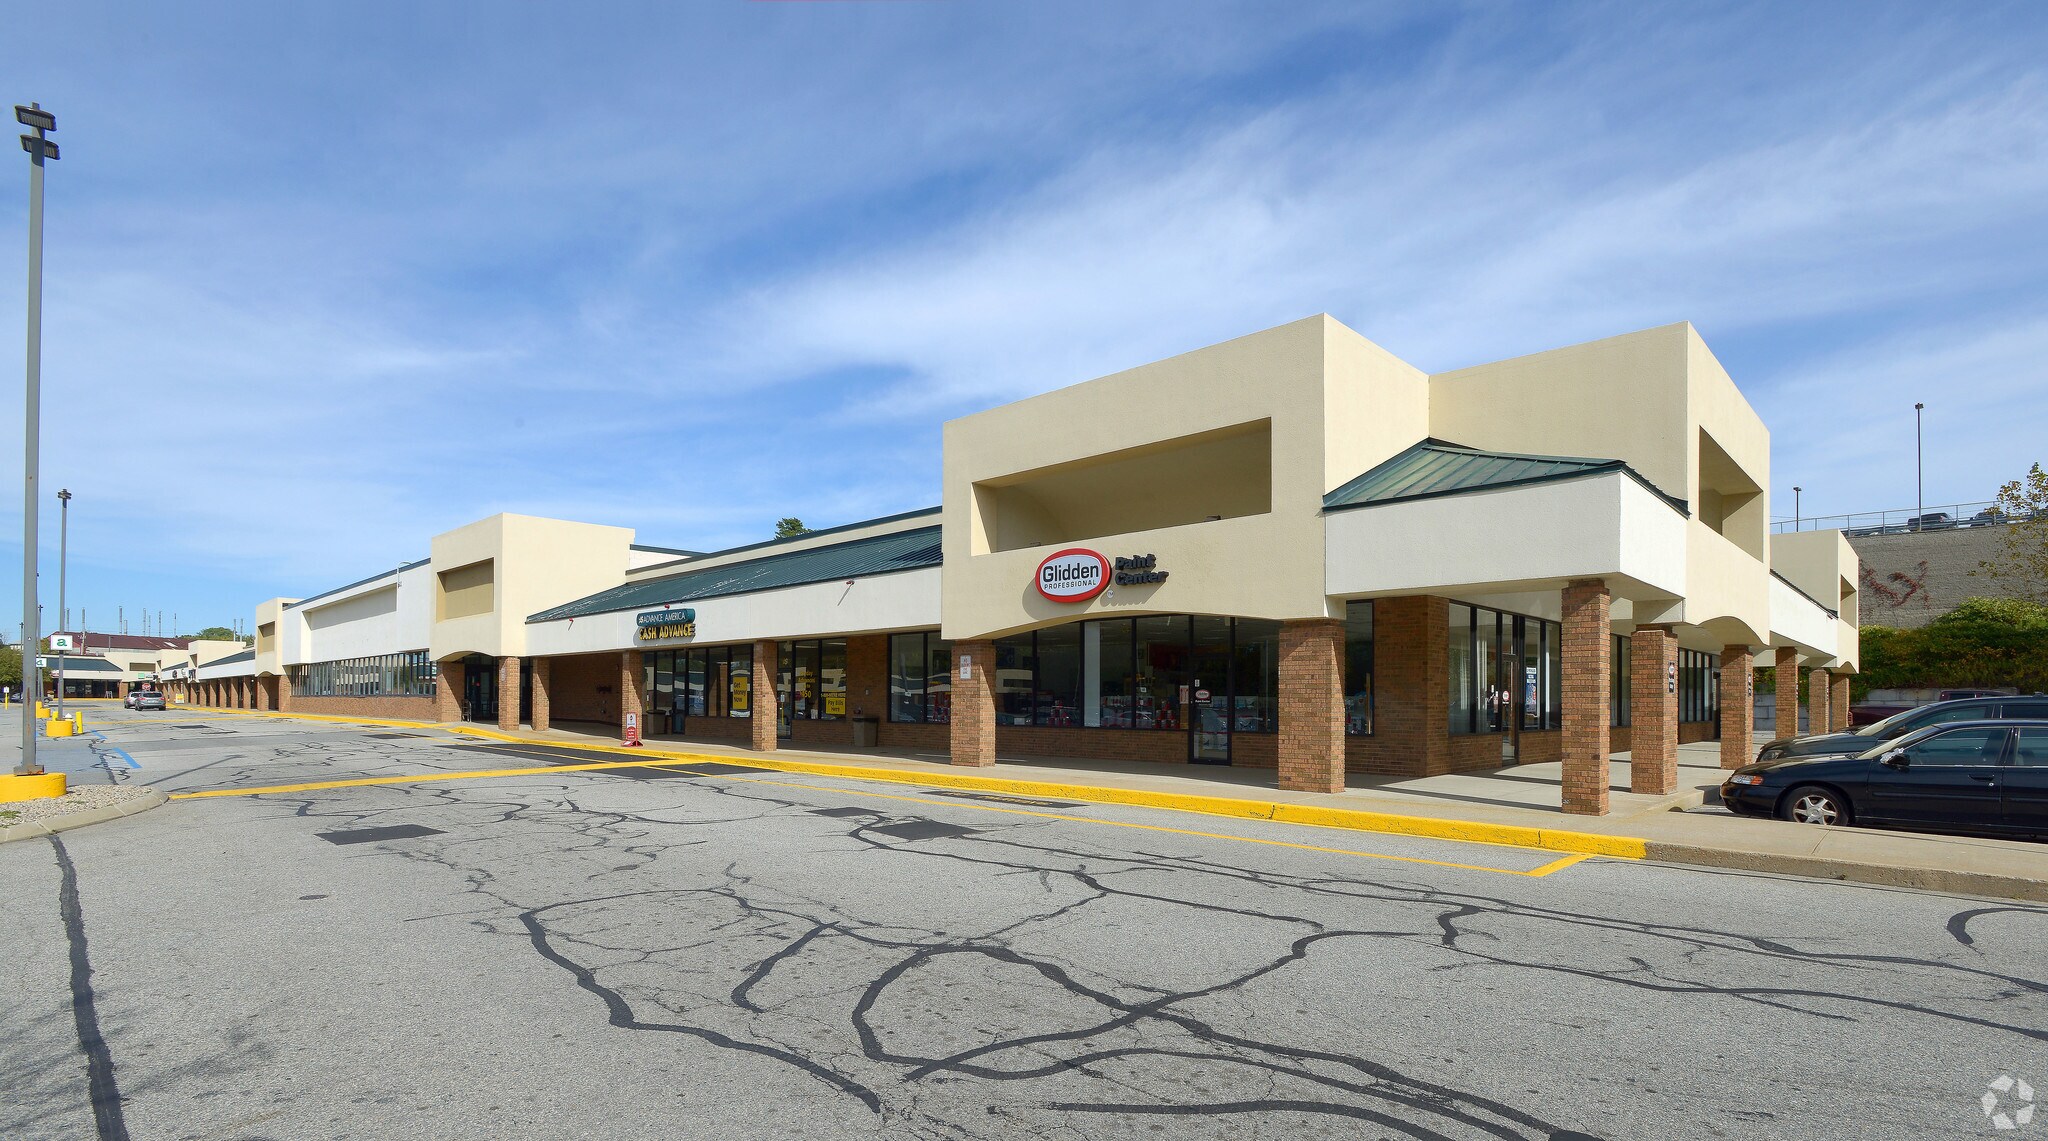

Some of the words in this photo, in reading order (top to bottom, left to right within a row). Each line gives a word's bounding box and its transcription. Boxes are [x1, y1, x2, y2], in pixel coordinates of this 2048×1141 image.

[1115, 554, 1157, 570] Paint
[1042, 563, 1099, 583] Glidden
[1115, 571, 1170, 586] Center
[1044, 580, 1097, 590] PROFESSIONAL
[643, 613, 663, 623] ADVANCE
[664, 611, 686, 622] AMERICA
[639, 627, 657, 641] CASH
[659, 623, 692, 638] ADVANCE
[56, 638, 68, 647] a
